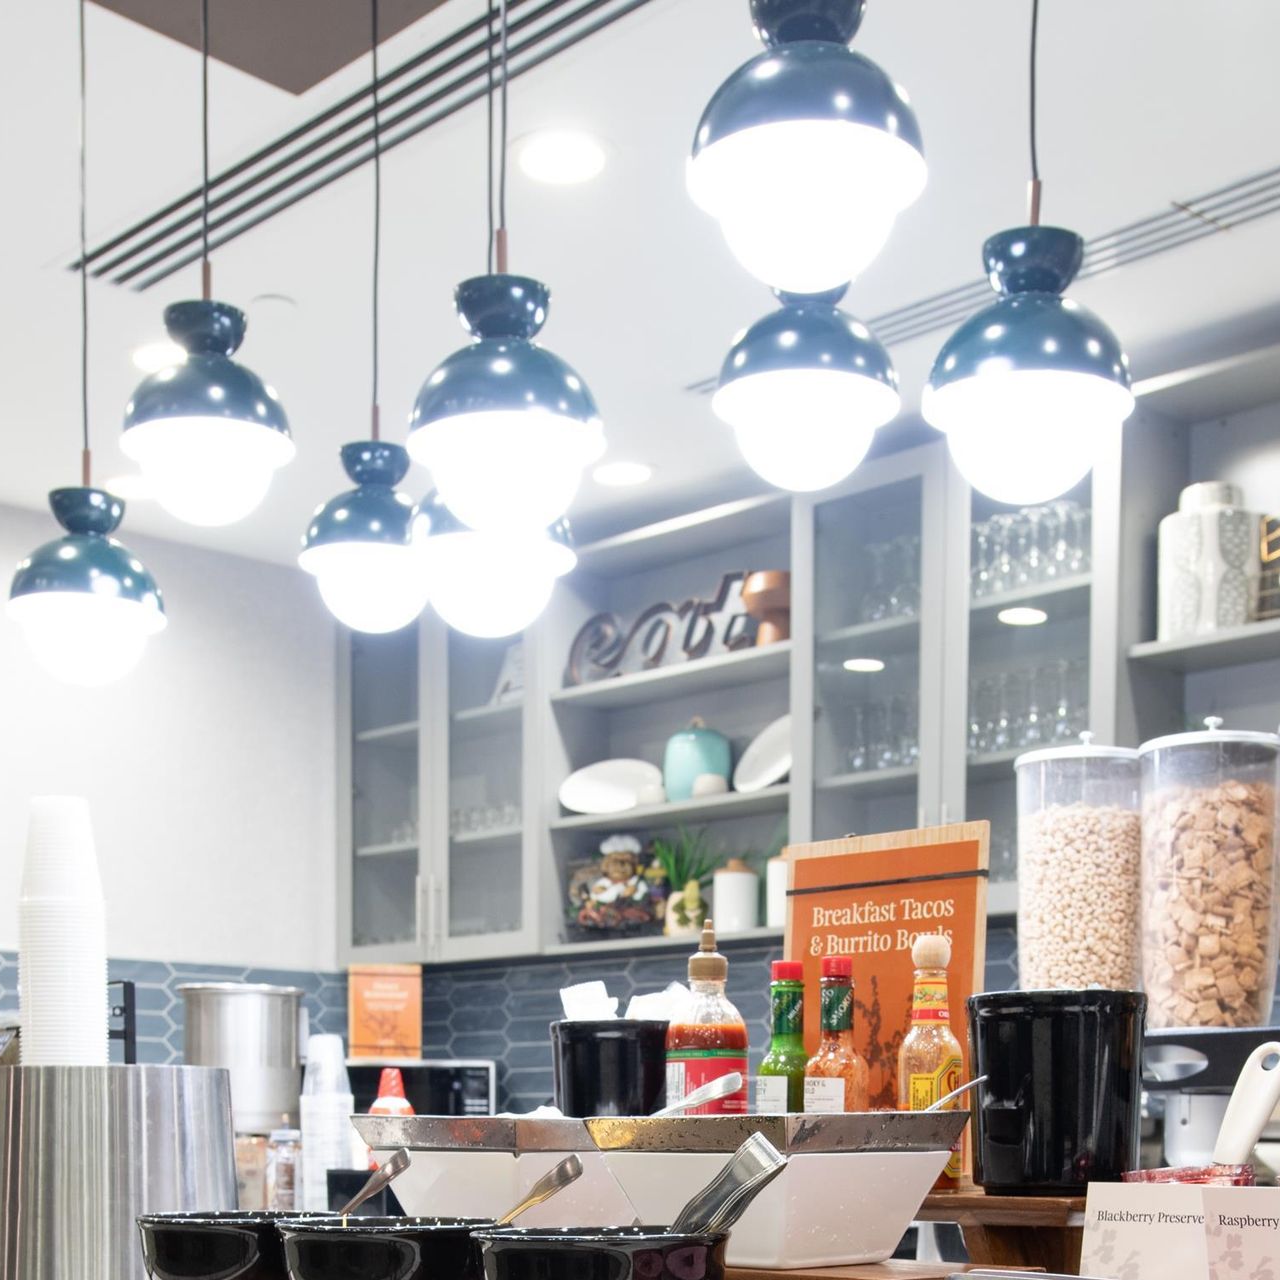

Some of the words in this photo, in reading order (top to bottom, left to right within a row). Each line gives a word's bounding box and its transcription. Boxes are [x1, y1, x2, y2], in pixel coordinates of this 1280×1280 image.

[812, 901, 896, 928] Breakfast
[900, 898, 954, 920] Tacos
[810, 935, 823, 957] &
[826, 930, 892, 955] Burrito
[896, 925, 953, 951] Bos
[1097, 1210, 1155, 1225] Blackberry
[1157, 1212, 1205, 1225] Preserve
[1219, 1214, 1279, 1230] Raspberry
